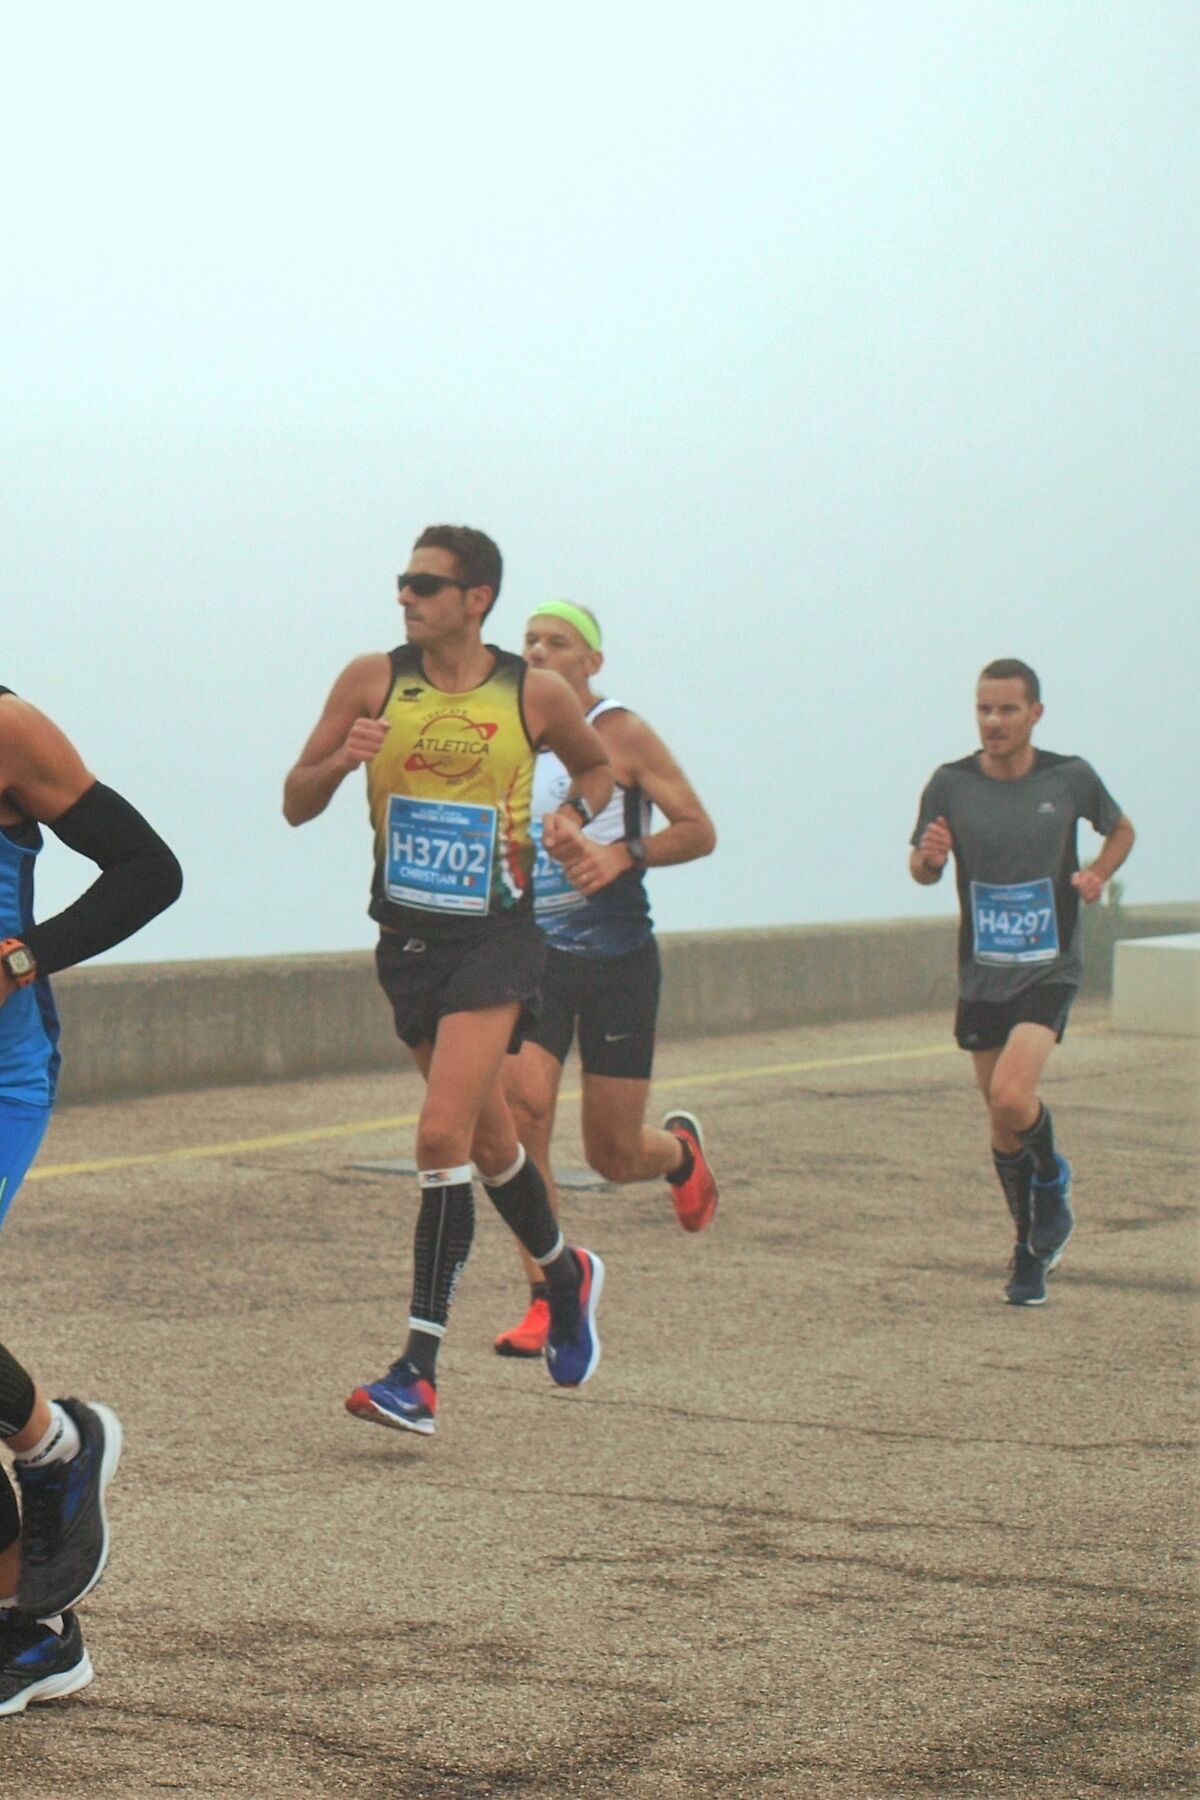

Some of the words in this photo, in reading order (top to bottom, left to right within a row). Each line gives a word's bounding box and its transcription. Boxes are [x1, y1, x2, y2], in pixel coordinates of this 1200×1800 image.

[413, 738, 489, 755] ATLETICA
[392, 831, 487, 874] H3702
[978, 908, 1052, 935] H4297
